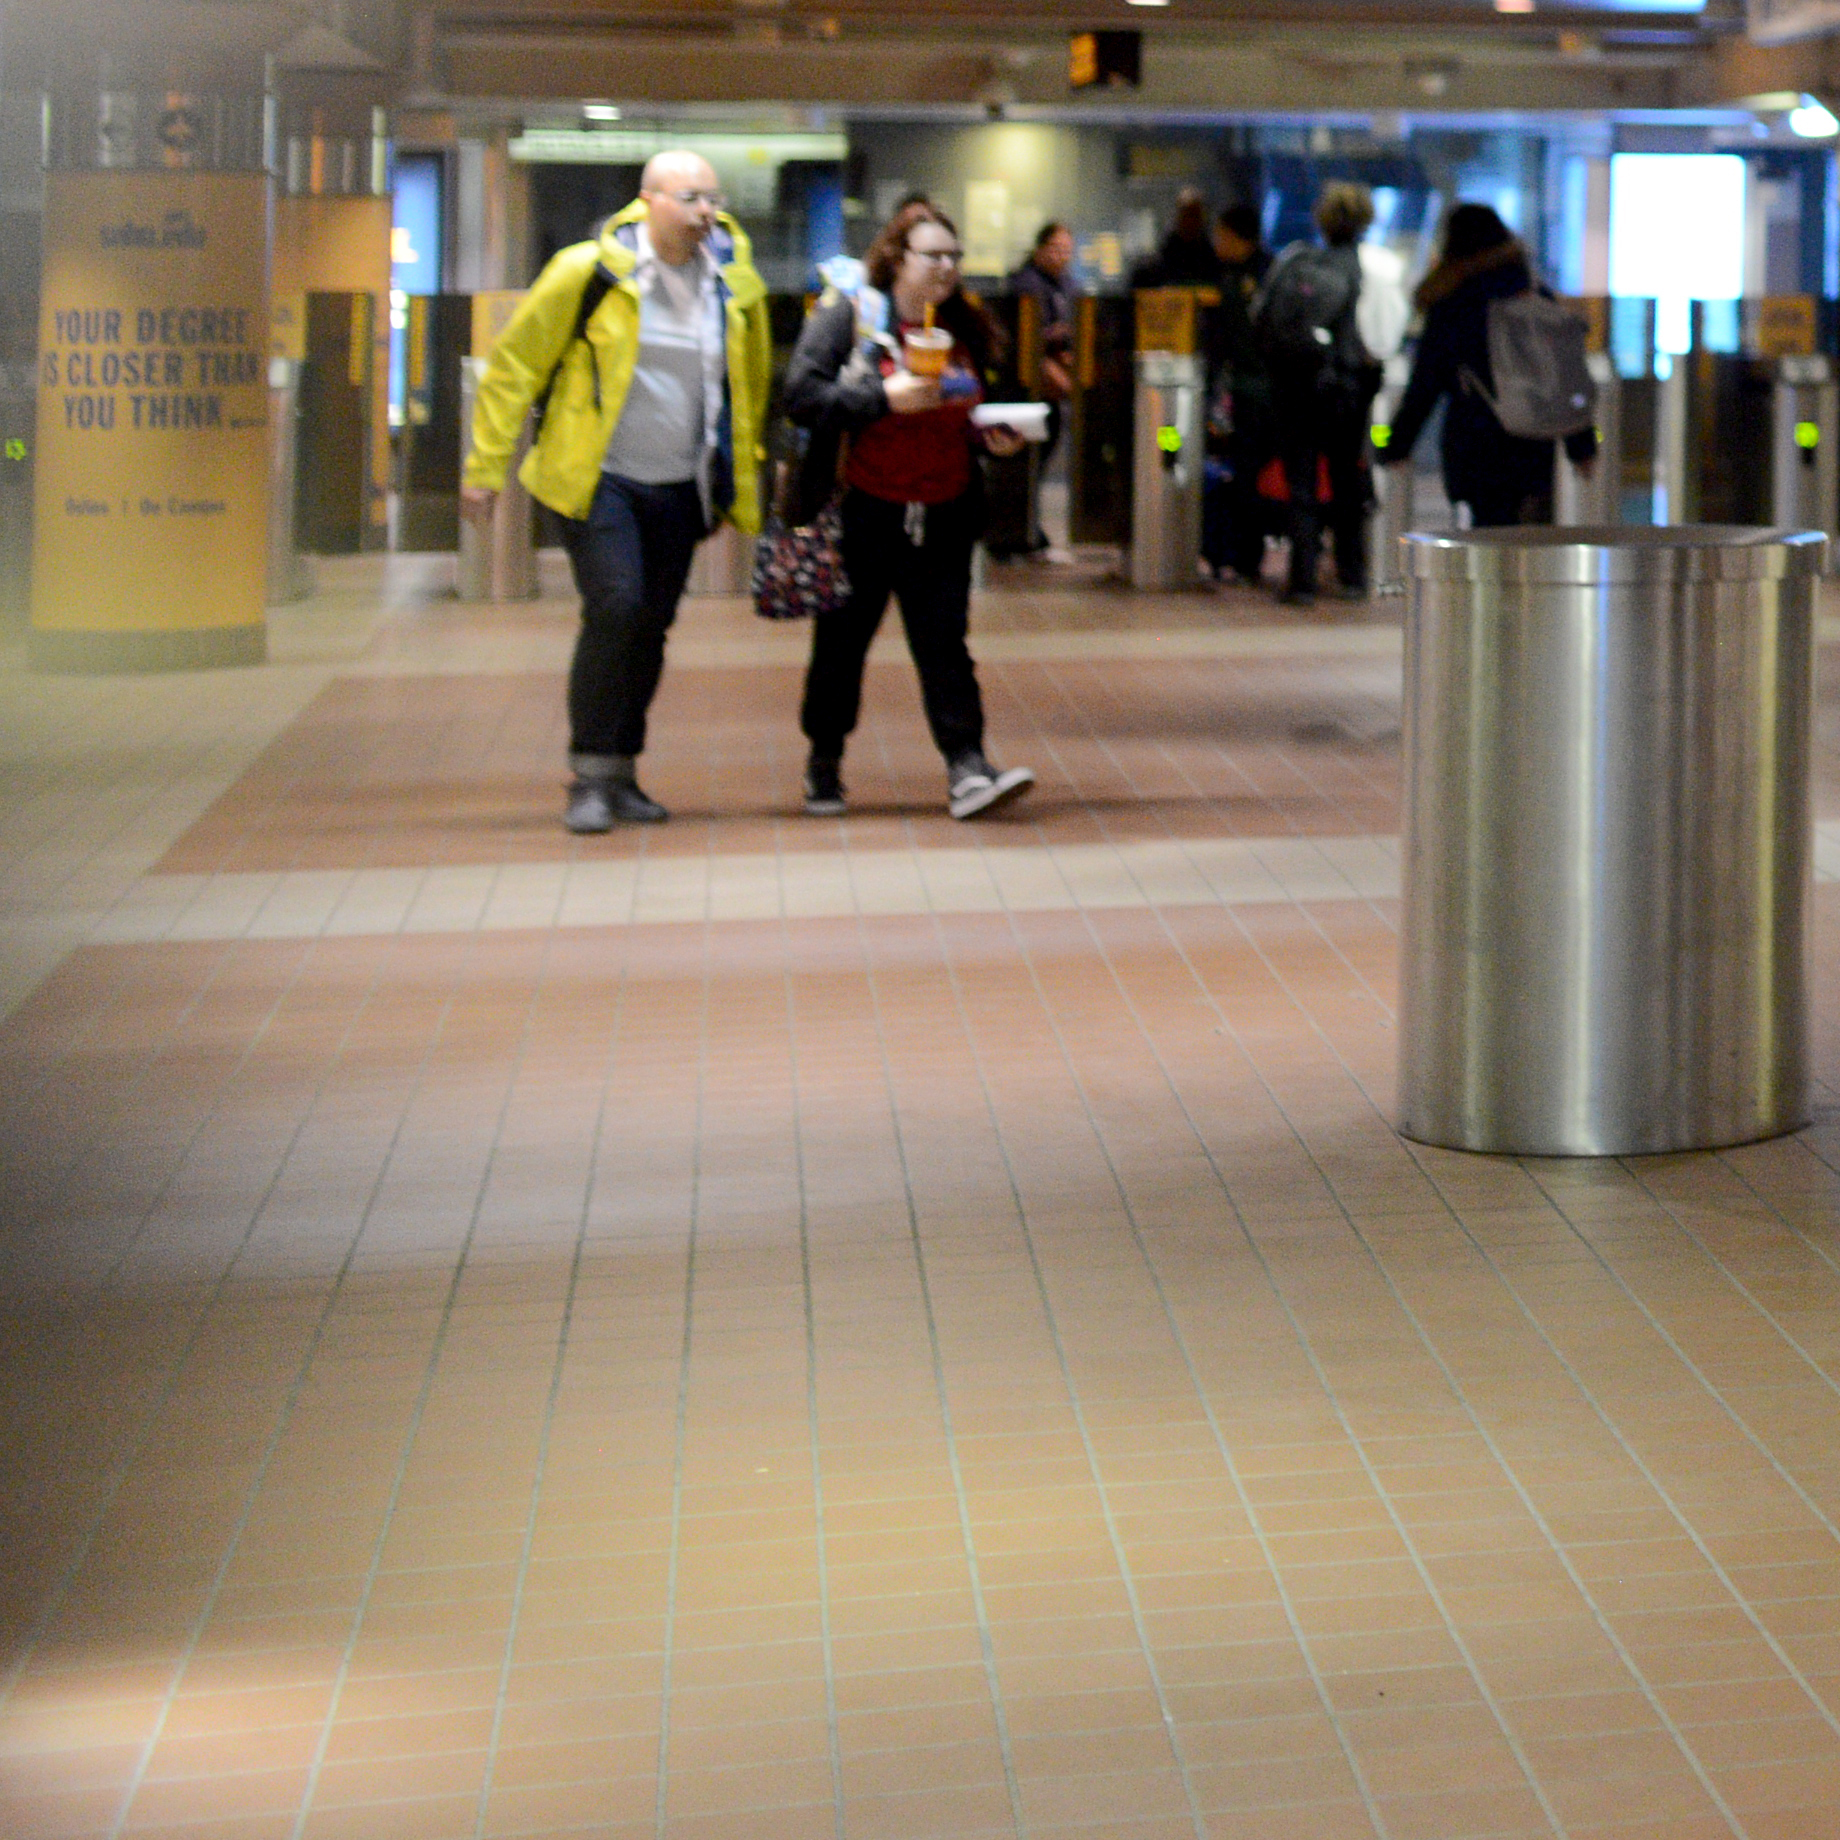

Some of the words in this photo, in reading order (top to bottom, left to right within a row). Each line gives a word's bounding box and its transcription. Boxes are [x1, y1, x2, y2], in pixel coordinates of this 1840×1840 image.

[54, 308, 121, 346] YOUR
[67, 352, 184, 388] CLOSER
[63, 394, 116, 430] YOU
